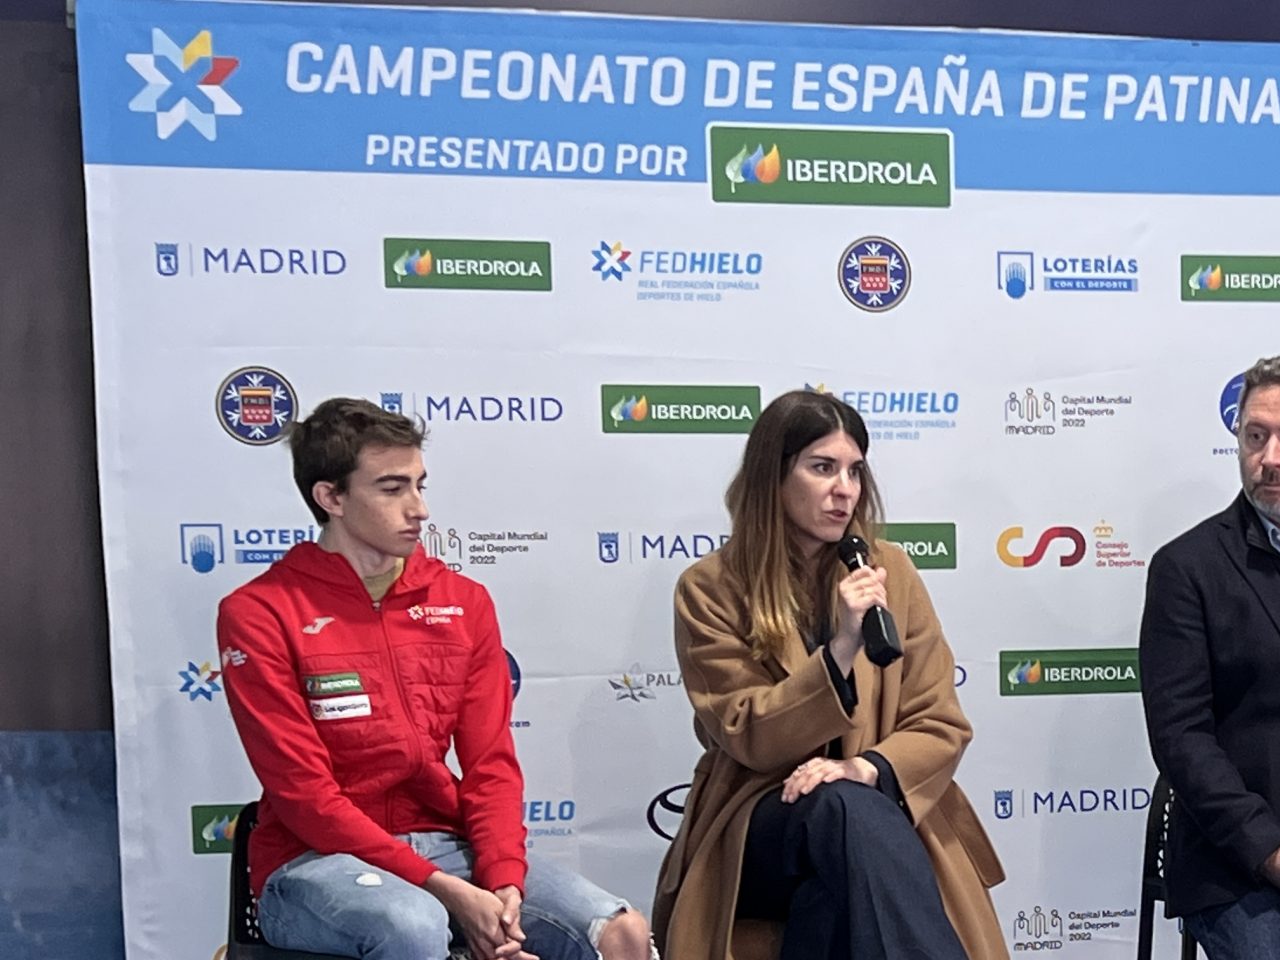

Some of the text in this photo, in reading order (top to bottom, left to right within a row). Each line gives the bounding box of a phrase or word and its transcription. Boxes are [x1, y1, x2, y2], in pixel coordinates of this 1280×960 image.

[286, 42, 686, 107] CAMPEONATO
[703, 58, 776, 109] DE
[791, 53, 1004, 118] ESPAÑA
[1020, 72, 1090, 121] DE
[366, 133, 688, 176] PRESENTADO POR
[786, 158, 938, 185] IBERDROLA
[203, 247, 347, 276] MADRID
[436, 258, 543, 278] IBERDROLA
[639, 250, 763, 275] FEDHIELO
[1042, 254, 1139, 274] LOTERÍAS
[1053, 280, 1073, 288] CON
[1087, 281, 1128, 289] DEPORTE
[1061, 395, 1132, 406] Capital Mundial
[426, 395, 563, 422] MADRID
[650, 404, 753, 420] IBERDROLA
[1077, 407, 1115, 417] Deporte
[1061, 418, 1086, 427] 2022
[234, 524, 314, 545] LOTERÍ
[468, 531, 548, 542] Capital Mundial
[468, 544, 529, 554] del Deporte
[1095, 541, 1129, 551] Consejo
[247, 552, 270, 561] CON
[469, 555, 497, 565] 2022
[1044, 665, 1137, 682] IBERDROLA
[1033, 788, 1151, 814] MADRID
[1068, 908, 1137, 921] Capital Mundial
[1068, 921, 1121, 931] del Deporte
[1069, 932, 1092, 942] 2022
